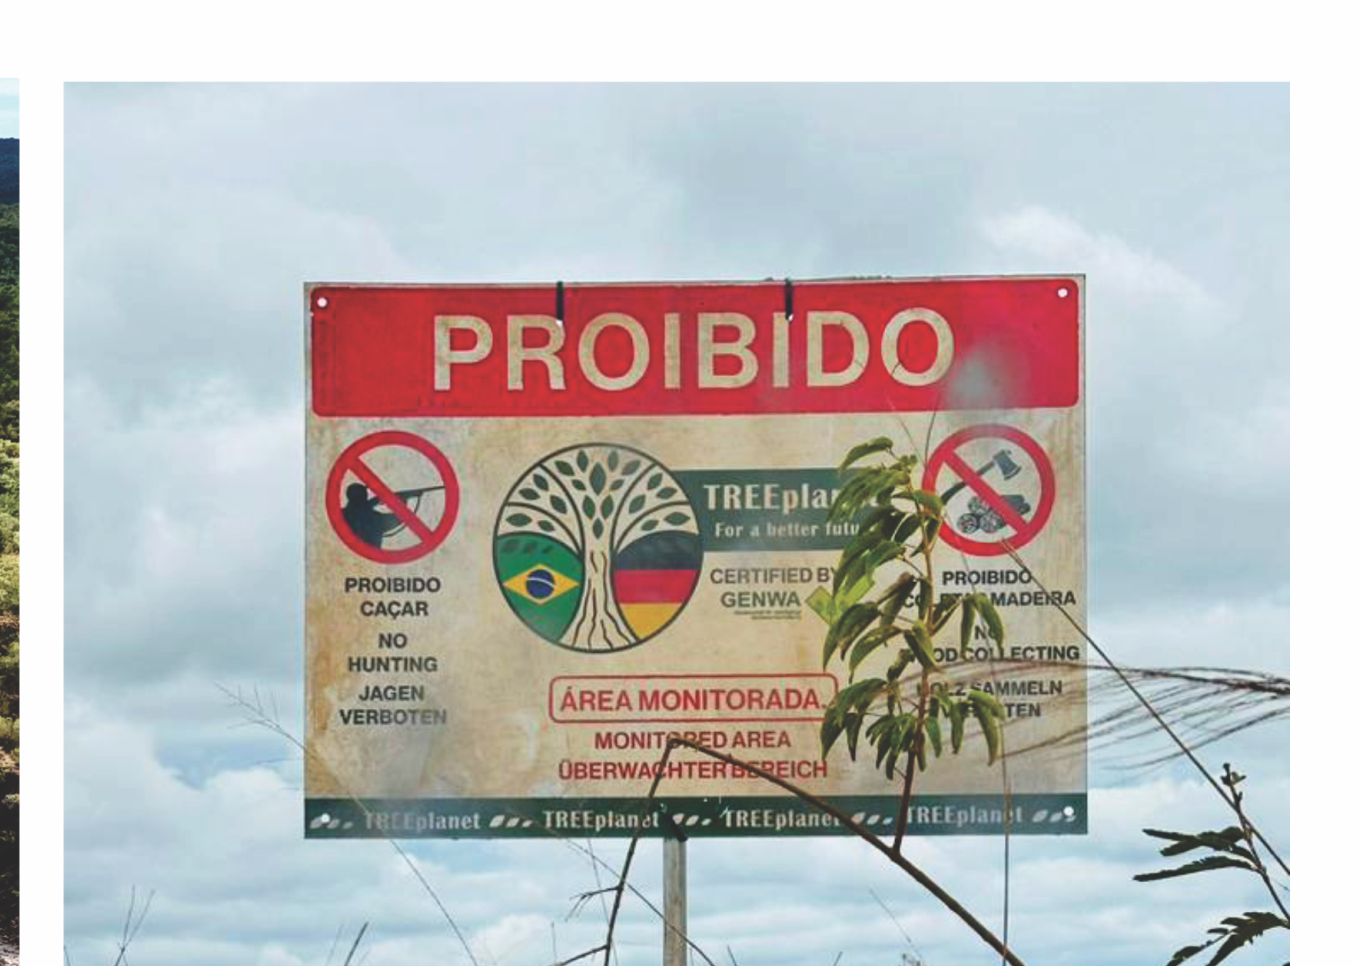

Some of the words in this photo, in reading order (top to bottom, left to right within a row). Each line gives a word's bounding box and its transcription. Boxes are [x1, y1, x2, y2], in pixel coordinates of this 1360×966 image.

[433, 306, 955, 393] PROIBIDO
[714, 521, 744, 538] For
[750, 525, 760, 538] a
[766, 521, 819, 538] better
[825, 520, 860, 538] futu
[709, 567, 813, 585] CERTIFIED
[942, 570, 1033, 585] PROIBIDO
[344, 577, 441, 594] PROIBIDO
[720, 591, 801, 609] GENWA
[991, 591, 1076, 607] MADEIRA
[360, 601, 429, 621] CAÇAR
[377, 632, 408, 650] NO
[348, 656, 439, 674] HUNTING
[358, 685, 426, 702] JAGEN
[559, 685, 632, 712] ÁREA
[339, 709, 448, 727] VERBOTEN
[594, 731, 728, 750] MONITORED
[732, 730, 792, 748] AREA
[558, 758, 727, 781] ÜBERWACHTER
[731, 759, 828, 779] BEREICH
[364, 811, 481, 833] TREEplanet
